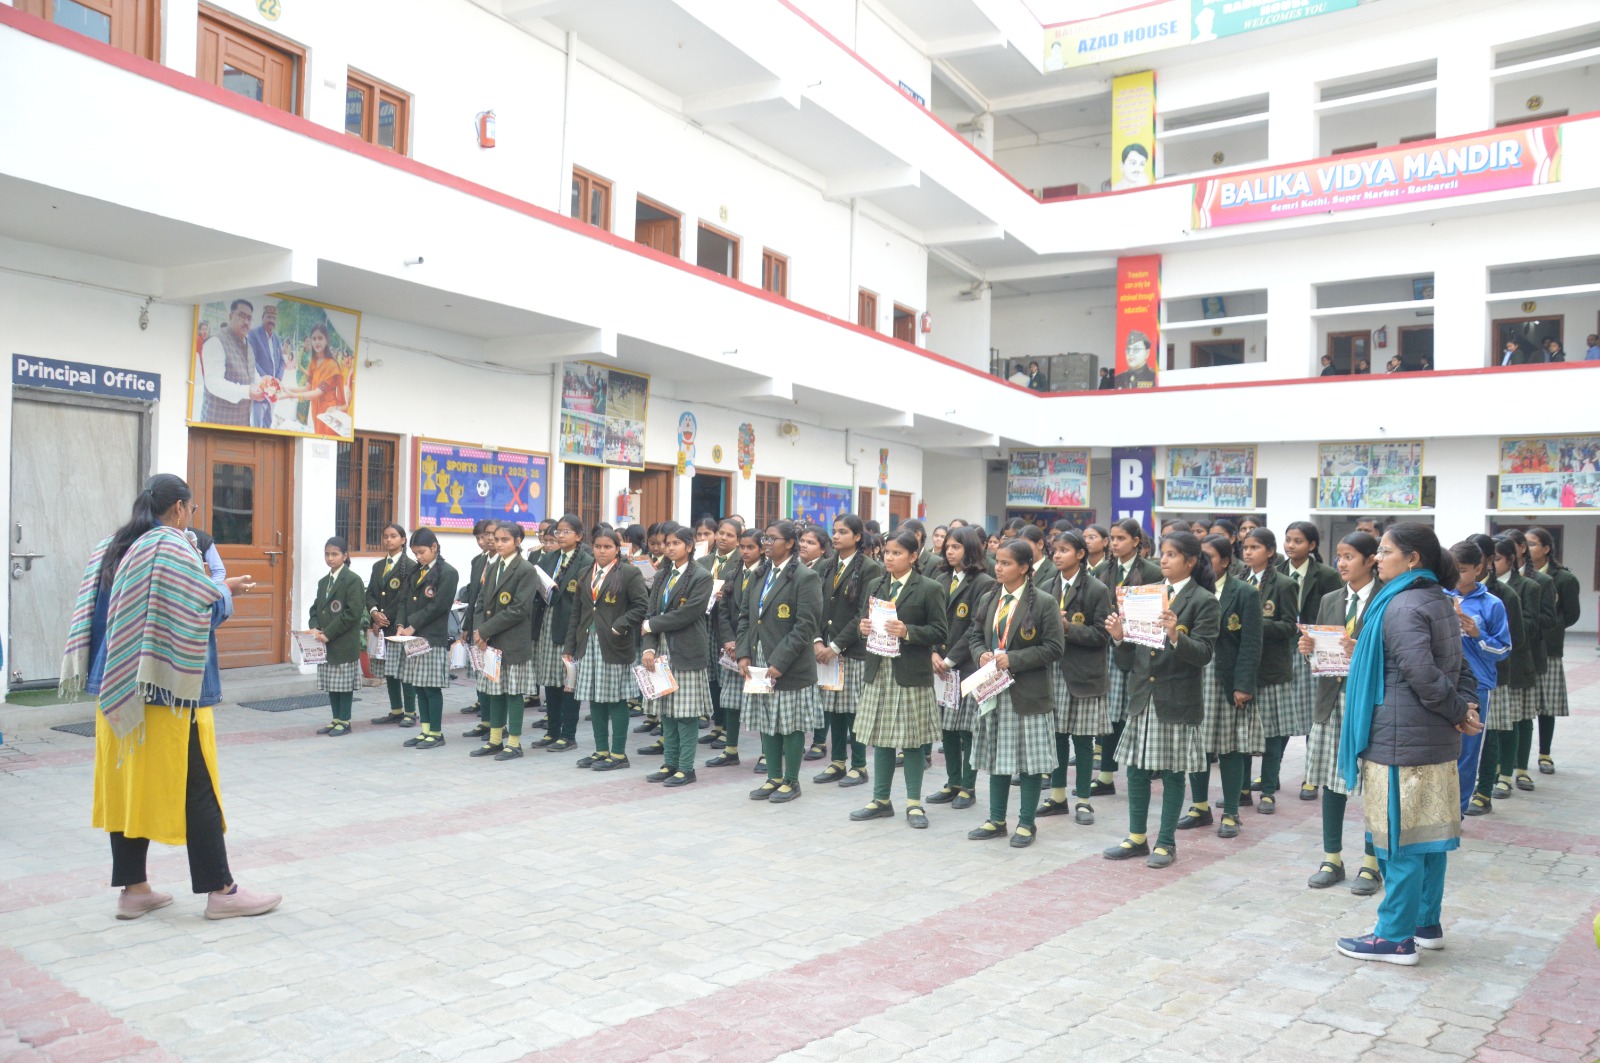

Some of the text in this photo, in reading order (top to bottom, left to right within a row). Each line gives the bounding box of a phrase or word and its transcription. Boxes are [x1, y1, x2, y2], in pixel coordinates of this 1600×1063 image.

[259, 0, 276, 16] 22
[1244, 9, 1303, 30] WELCOMES
[1304, 2, 1328, 16] YOU
[1077, 32, 1119, 54] AZAD
[1123, 20, 1178, 44] HOUSE
[1220, 139, 1522, 207] BALIKA VIDYA MANDIR
[1271, 201, 1299, 212] Semri
[1332, 193, 1362, 204] Super
[1364, 188, 1399, 200] Market
[1407, 180, 1458, 195] Raebareli
[17, 358, 155, 392] Principal Office
[446, 460, 477, 473] SPORTS
[482, 463, 504, 476] MEET
